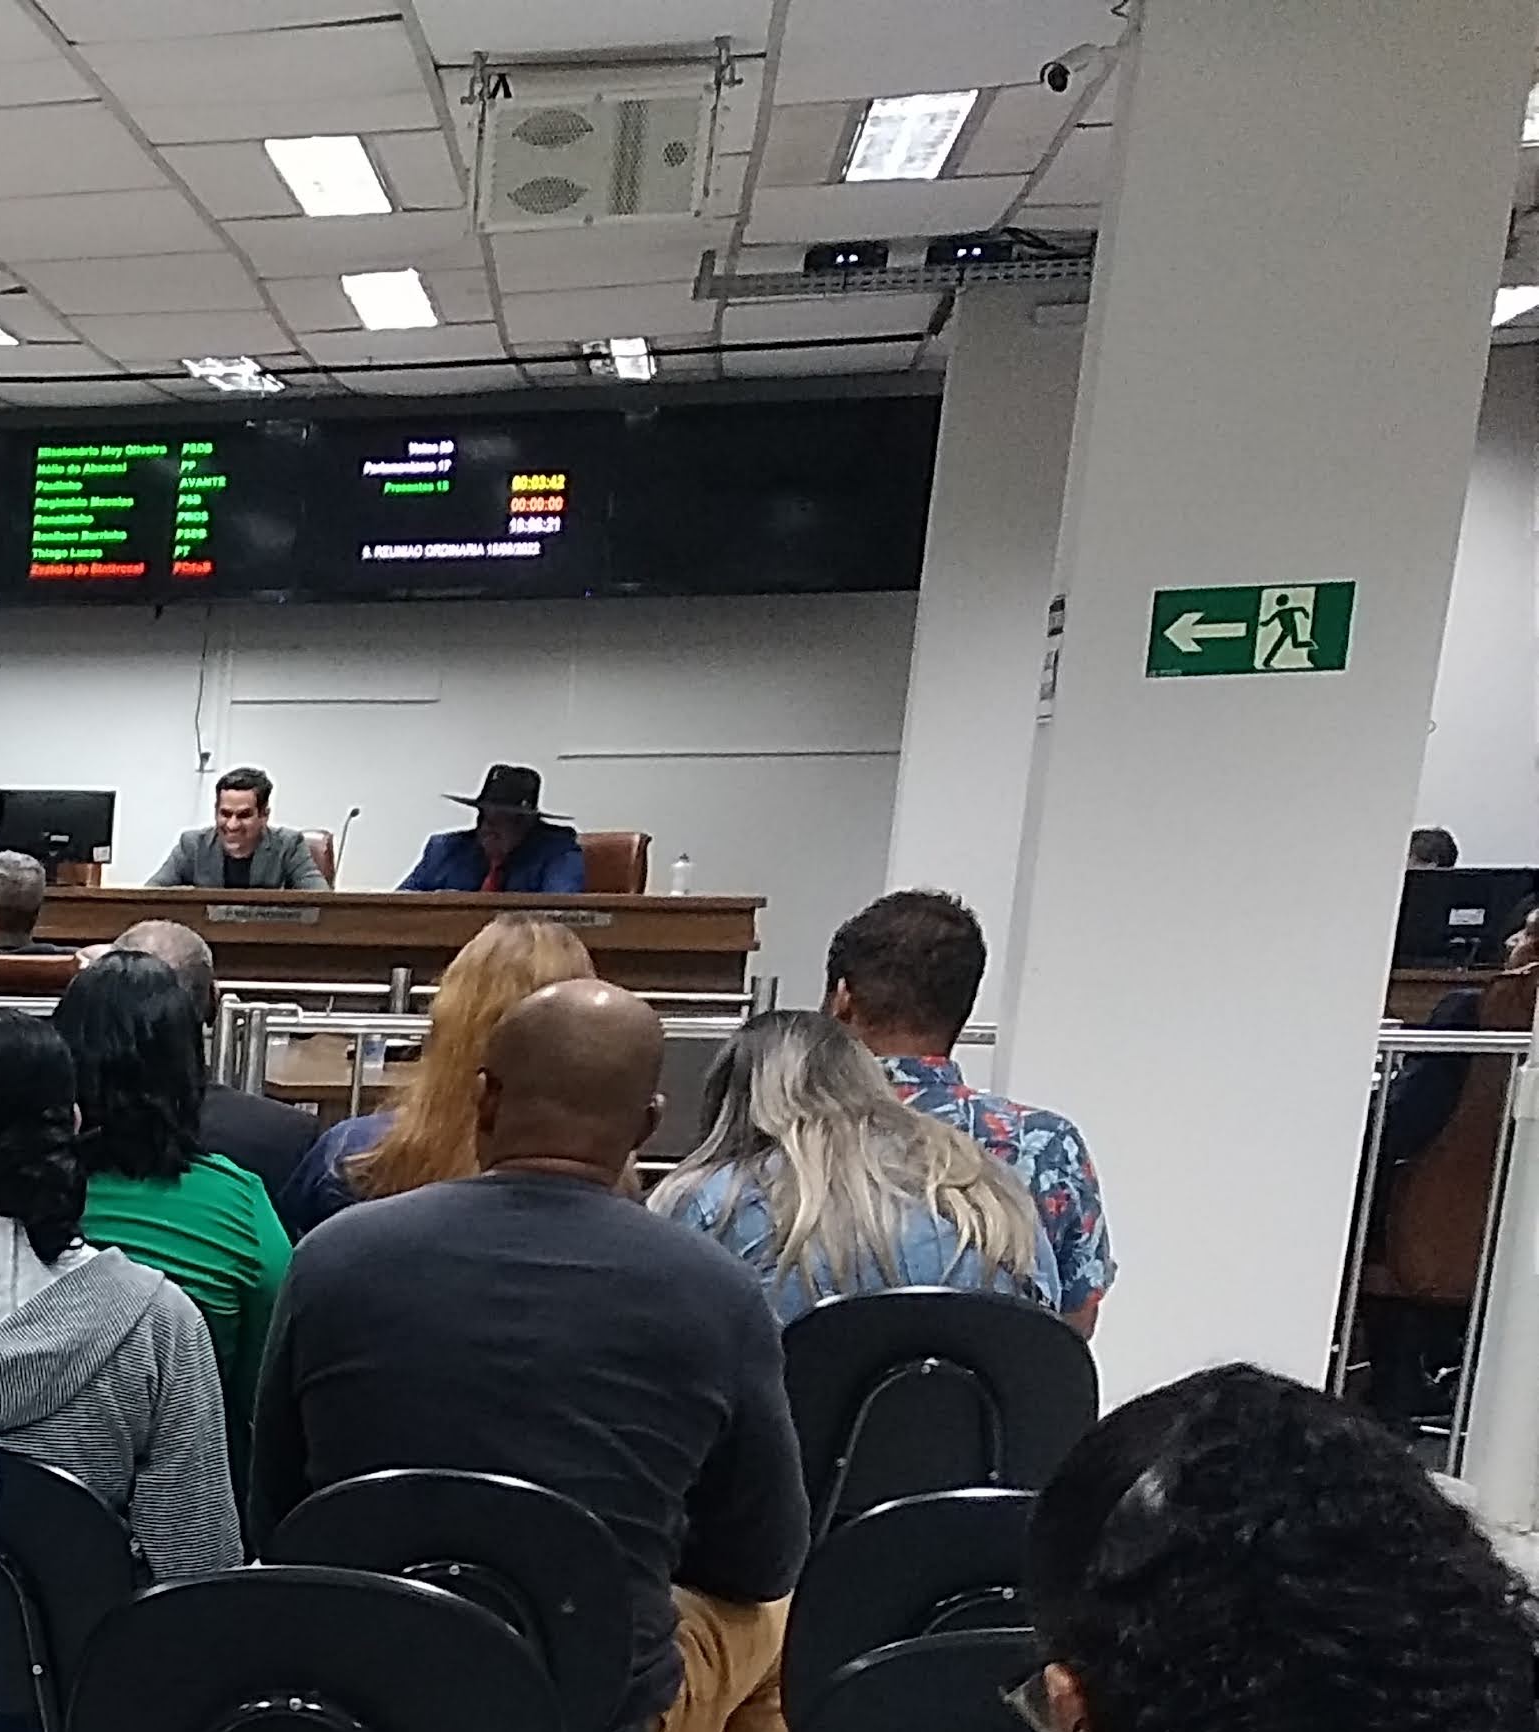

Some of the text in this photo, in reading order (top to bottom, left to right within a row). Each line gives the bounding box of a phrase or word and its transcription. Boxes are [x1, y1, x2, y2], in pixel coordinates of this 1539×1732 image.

[179, 460, 196, 474] PP
[179, 476, 226, 489] AVANTE
[511, 496, 564, 512] 00:00:00
[174, 545, 190, 558] PT
